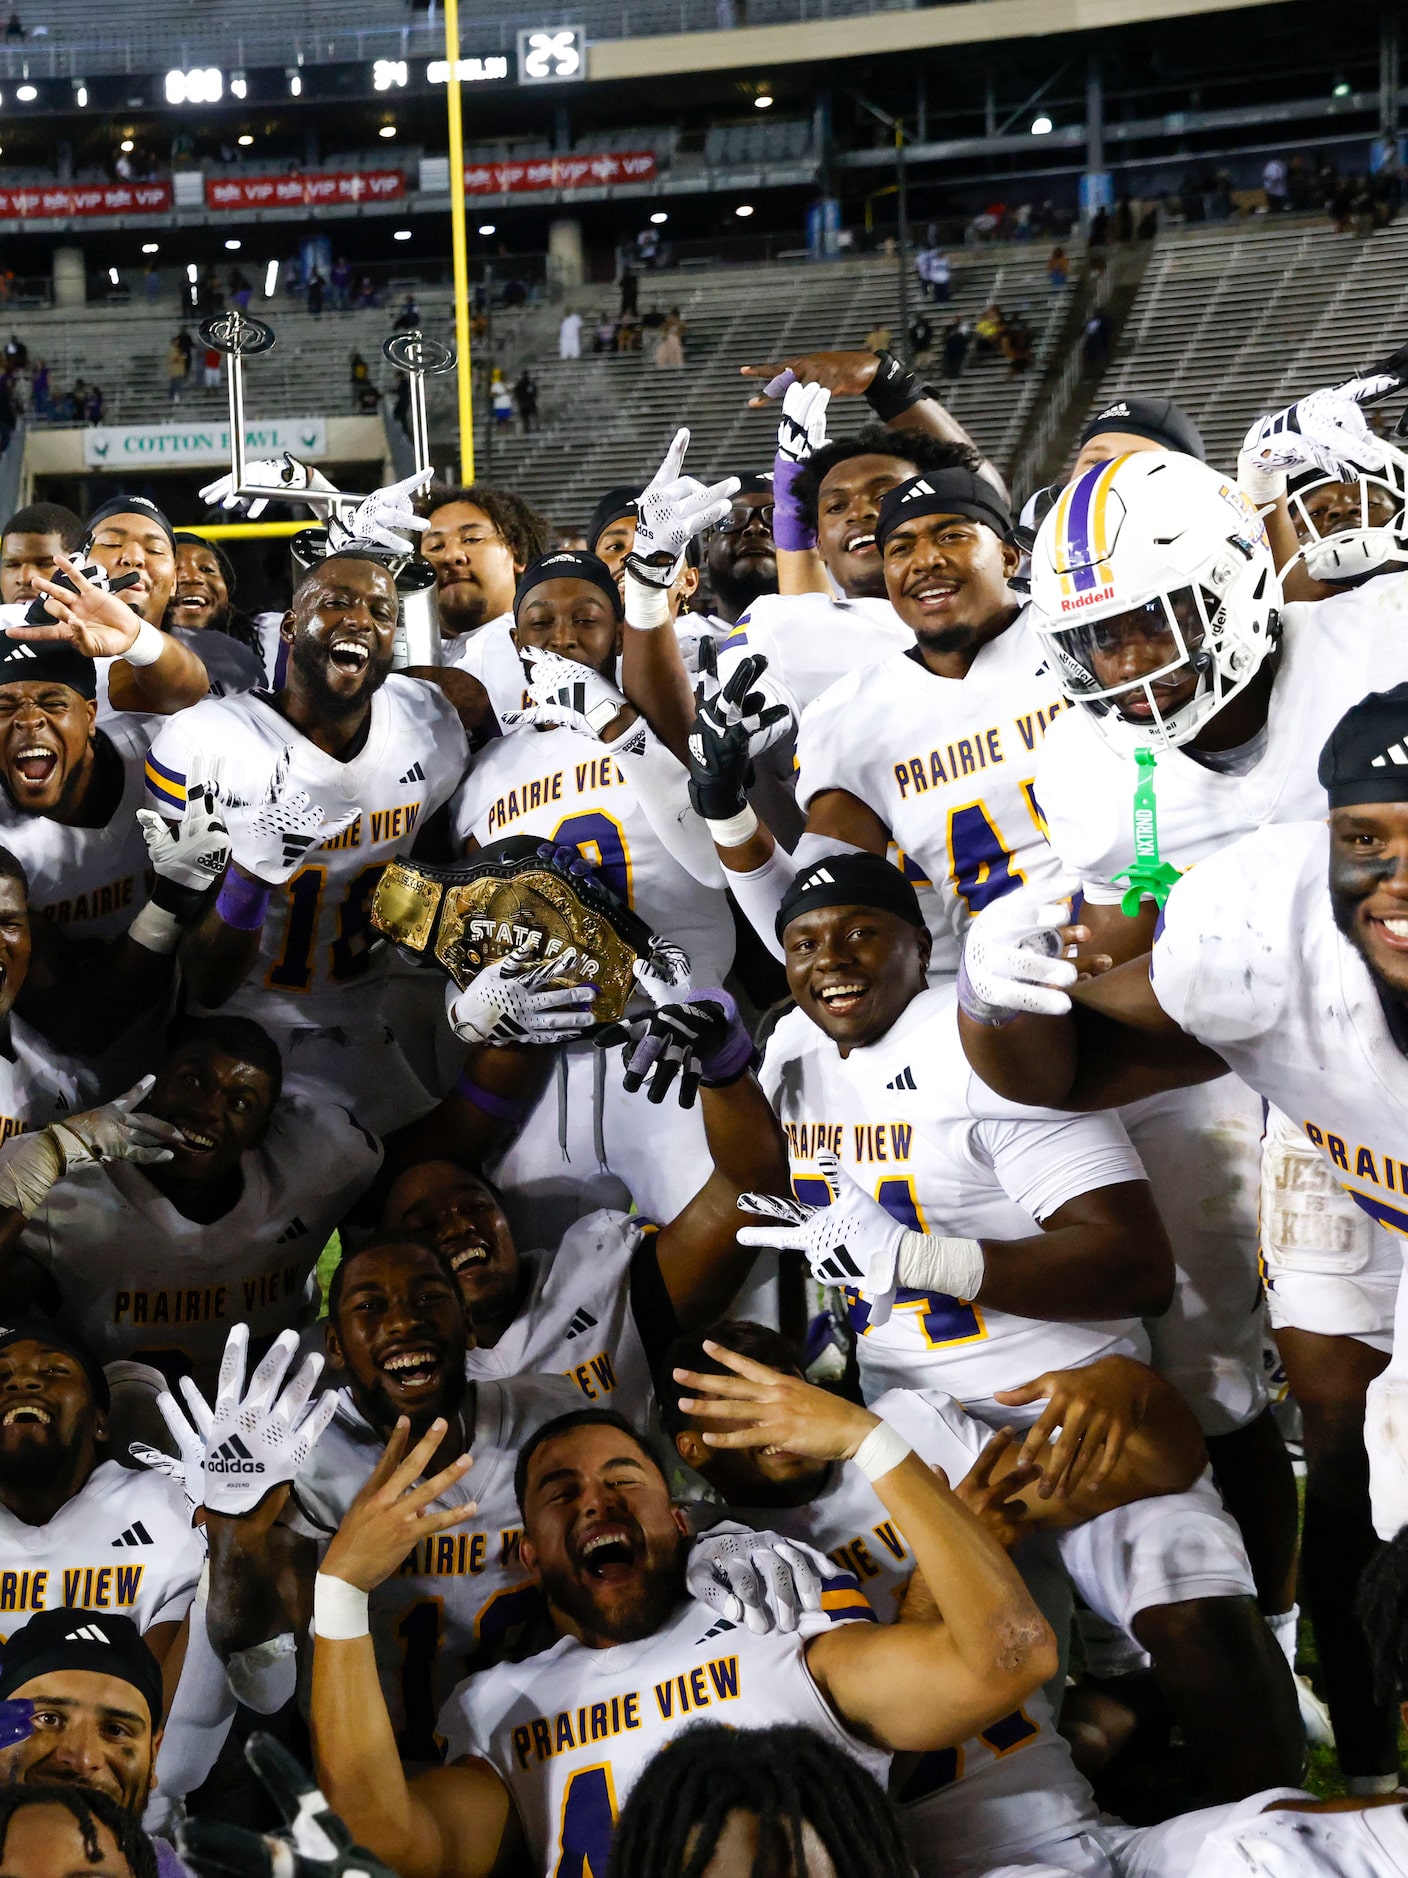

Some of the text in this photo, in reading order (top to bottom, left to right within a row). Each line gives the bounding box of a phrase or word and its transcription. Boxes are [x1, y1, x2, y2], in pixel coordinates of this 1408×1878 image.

[124, 432, 213, 454] COTTON
[1061, 587, 1116, 612] Riddell
[1058, 651, 1096, 687] Riddell
[893, 726, 1006, 800] PRAIRIE
[370, 801, 421, 844] VIEW
[488, 770, 564, 836] PRAIRIE
[1135, 808, 1155, 857] NXTRND
[469, 919, 543, 950] STATE
[854, 1120, 917, 1164] VIEW
[113, 1263, 302, 1327] PRAIRIE VIEW
[563, 1350, 619, 1401] EW
[208, 1459, 265, 1473] adidas
[397, 1532, 489, 1577] AIRIE
[62, 1564, 145, 1609] VIEW
[512, 1655, 741, 1773] PRAIRIE VIEW
